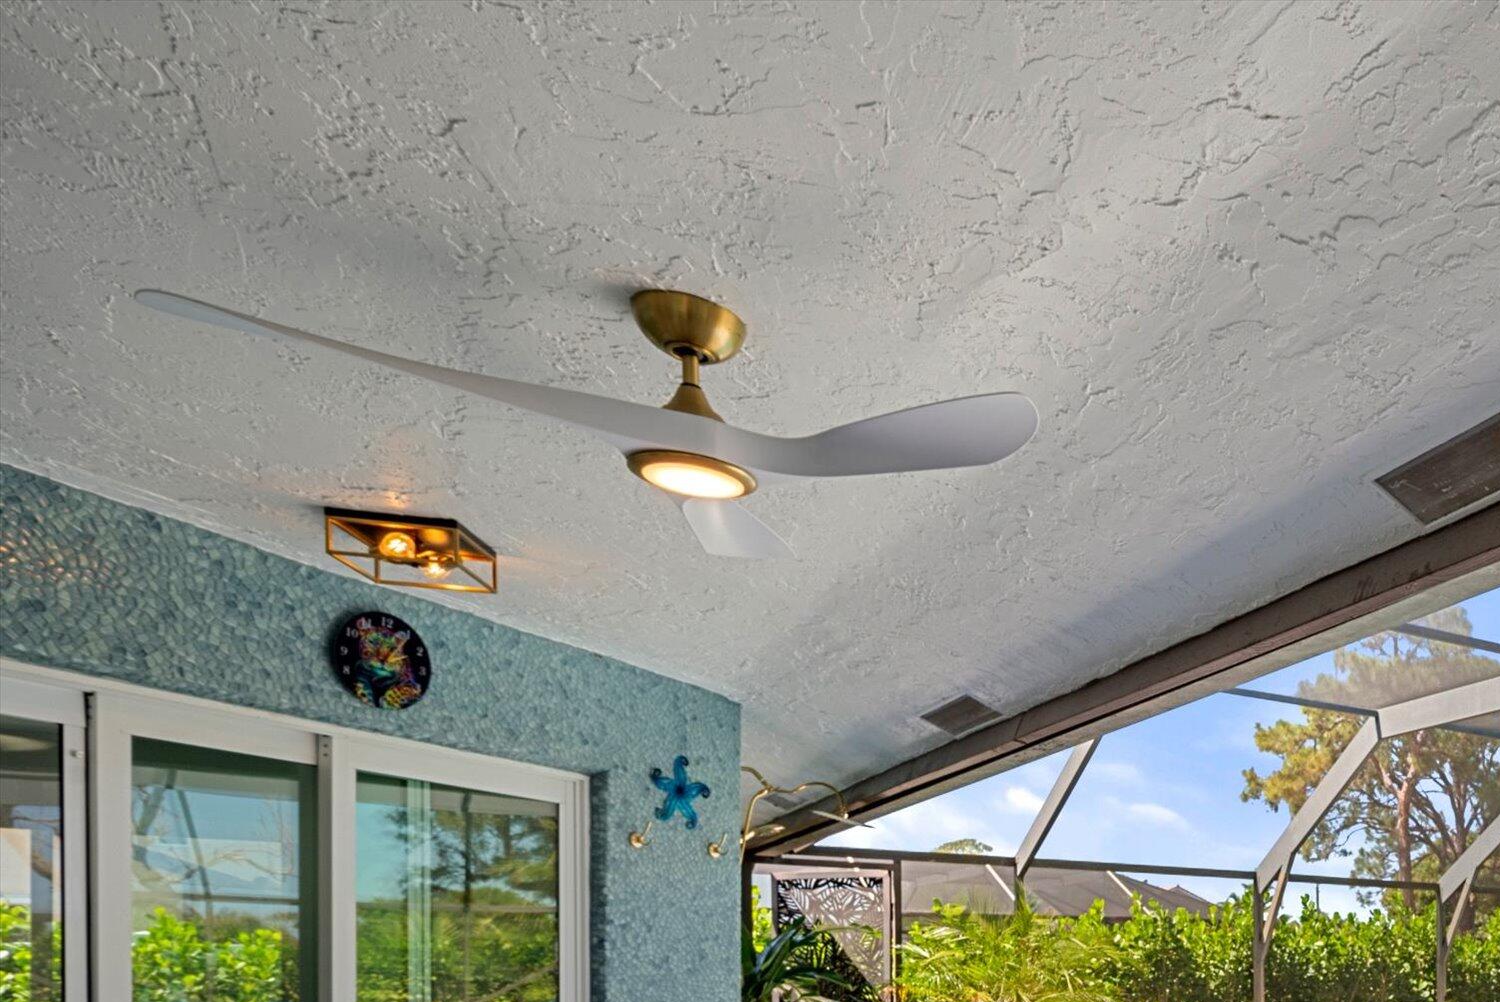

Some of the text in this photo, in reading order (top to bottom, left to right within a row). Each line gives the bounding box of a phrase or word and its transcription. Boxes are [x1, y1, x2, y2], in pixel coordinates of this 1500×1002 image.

[381, 616, 394, 629] 12
[346, 627, 358, 638] 10
[340, 646, 349, 656] 9
[416, 646, 424, 657] 2
[342, 665, 351, 676] 8
[419, 666, 427, 676] 3
